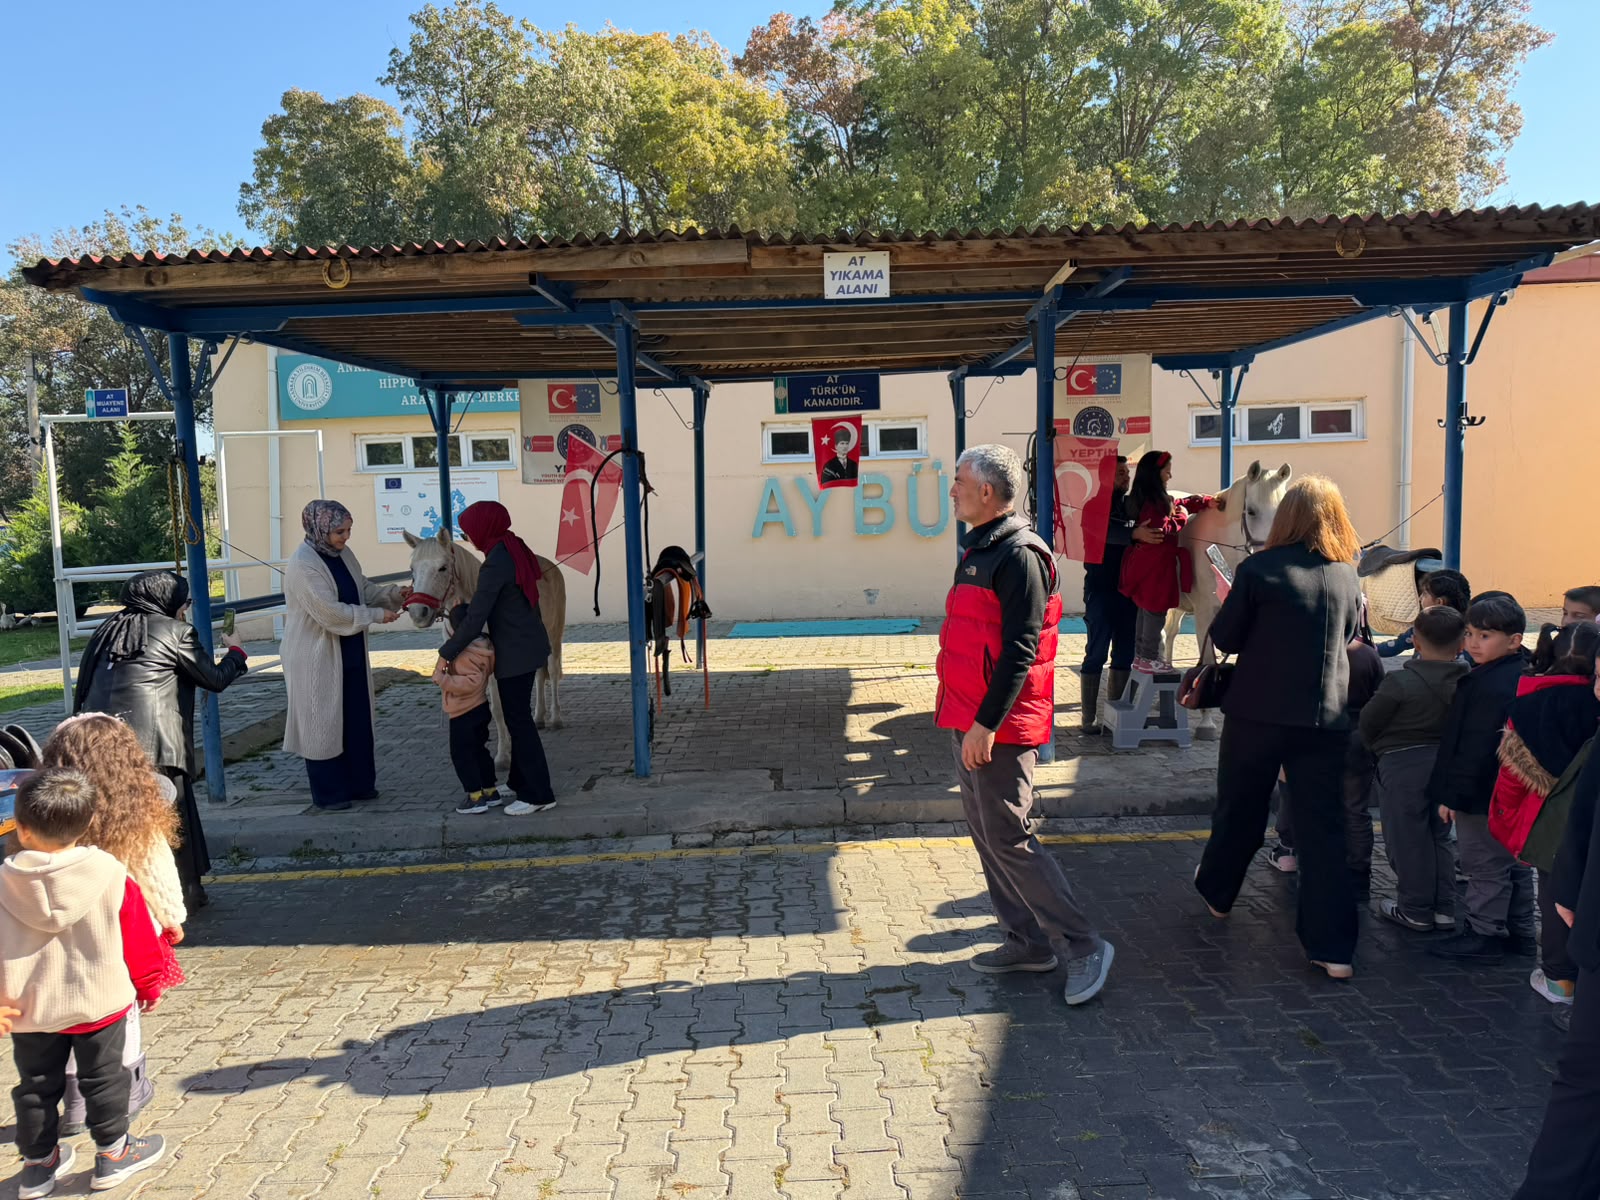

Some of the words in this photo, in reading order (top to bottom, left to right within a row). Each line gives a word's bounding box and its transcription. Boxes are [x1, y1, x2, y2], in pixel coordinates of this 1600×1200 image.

[848, 256, 866, 266] AT
[830, 269, 884, 281] YIKAMA
[836, 284, 878, 295] ALANI
[826, 375, 840, 384] AT
[811, 385, 856, 395] TÜRK'ÜN
[804, 397, 863, 407] KANADIDIR.
[752, 459, 950, 538] AYBÜ
